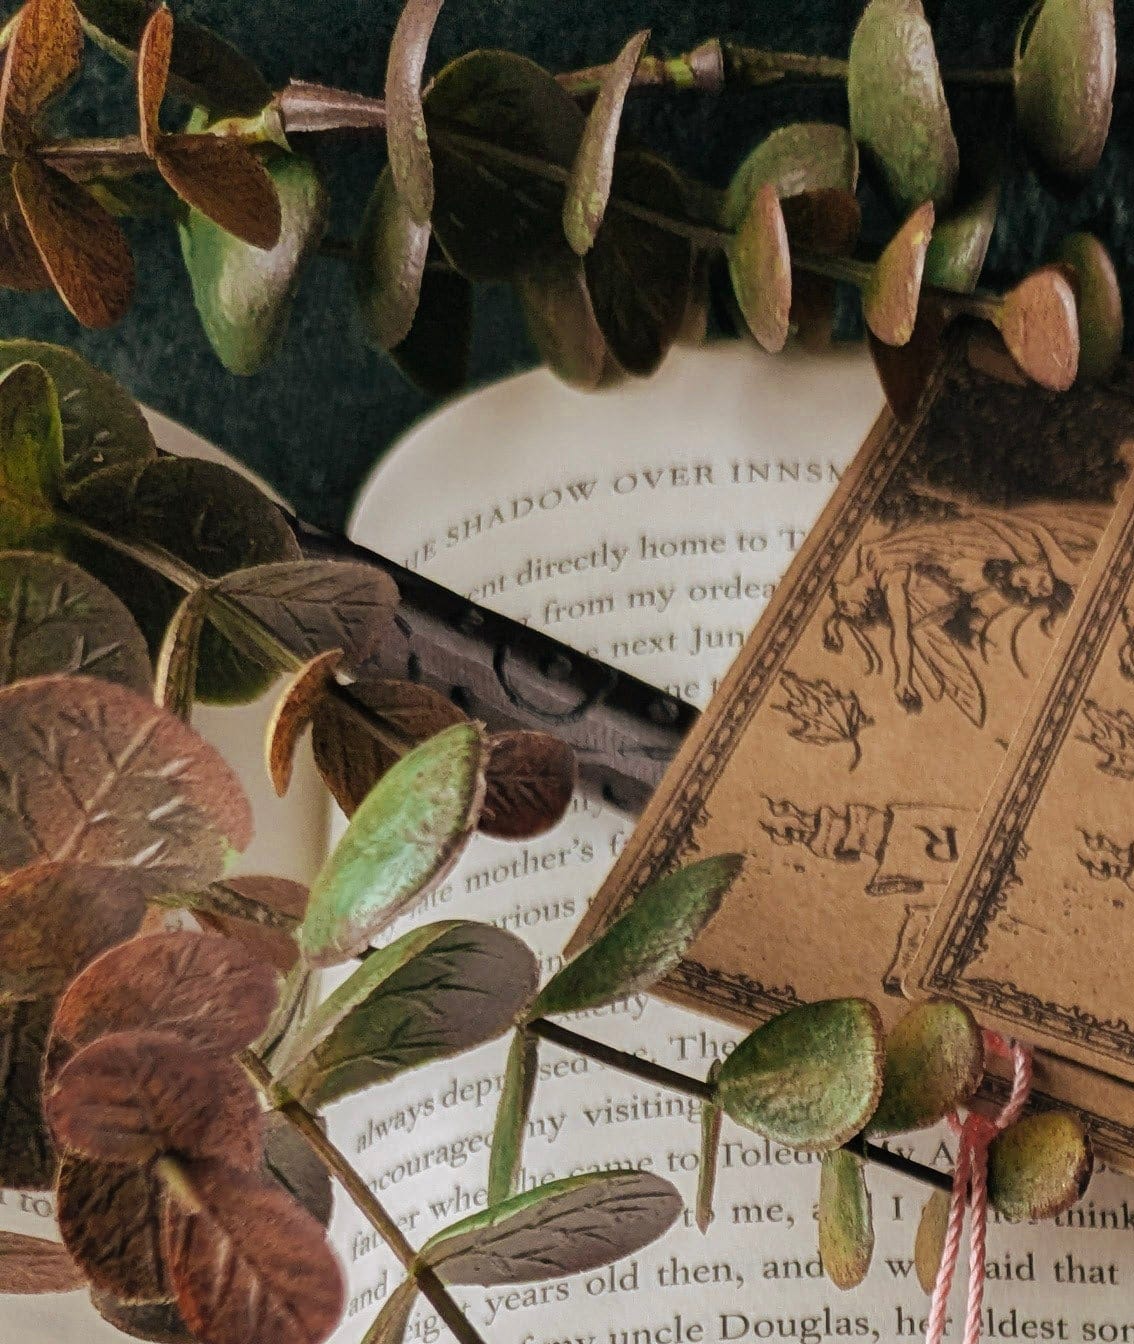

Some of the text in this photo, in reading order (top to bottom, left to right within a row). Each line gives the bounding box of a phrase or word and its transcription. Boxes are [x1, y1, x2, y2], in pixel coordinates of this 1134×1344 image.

[448, 463, 713, 542] SHADOW OVER
[516, 532, 767, 586] directly home to
[543, 586, 675, 624] from my
[612, 632, 677, 657] next
[464, 839, 593, 893] mother's
[355, 1098, 435, 1154] always
[583, 1091, 702, 1128] visiting
[732, 1203, 794, 1229] me,
[483, 1282, 569, 1326] years
[584, 1260, 639, 1296] old
[657, 1256, 744, 1289] then,
[762, 1253, 824, 1280] and
[1053, 1251, 1119, 1285] that
